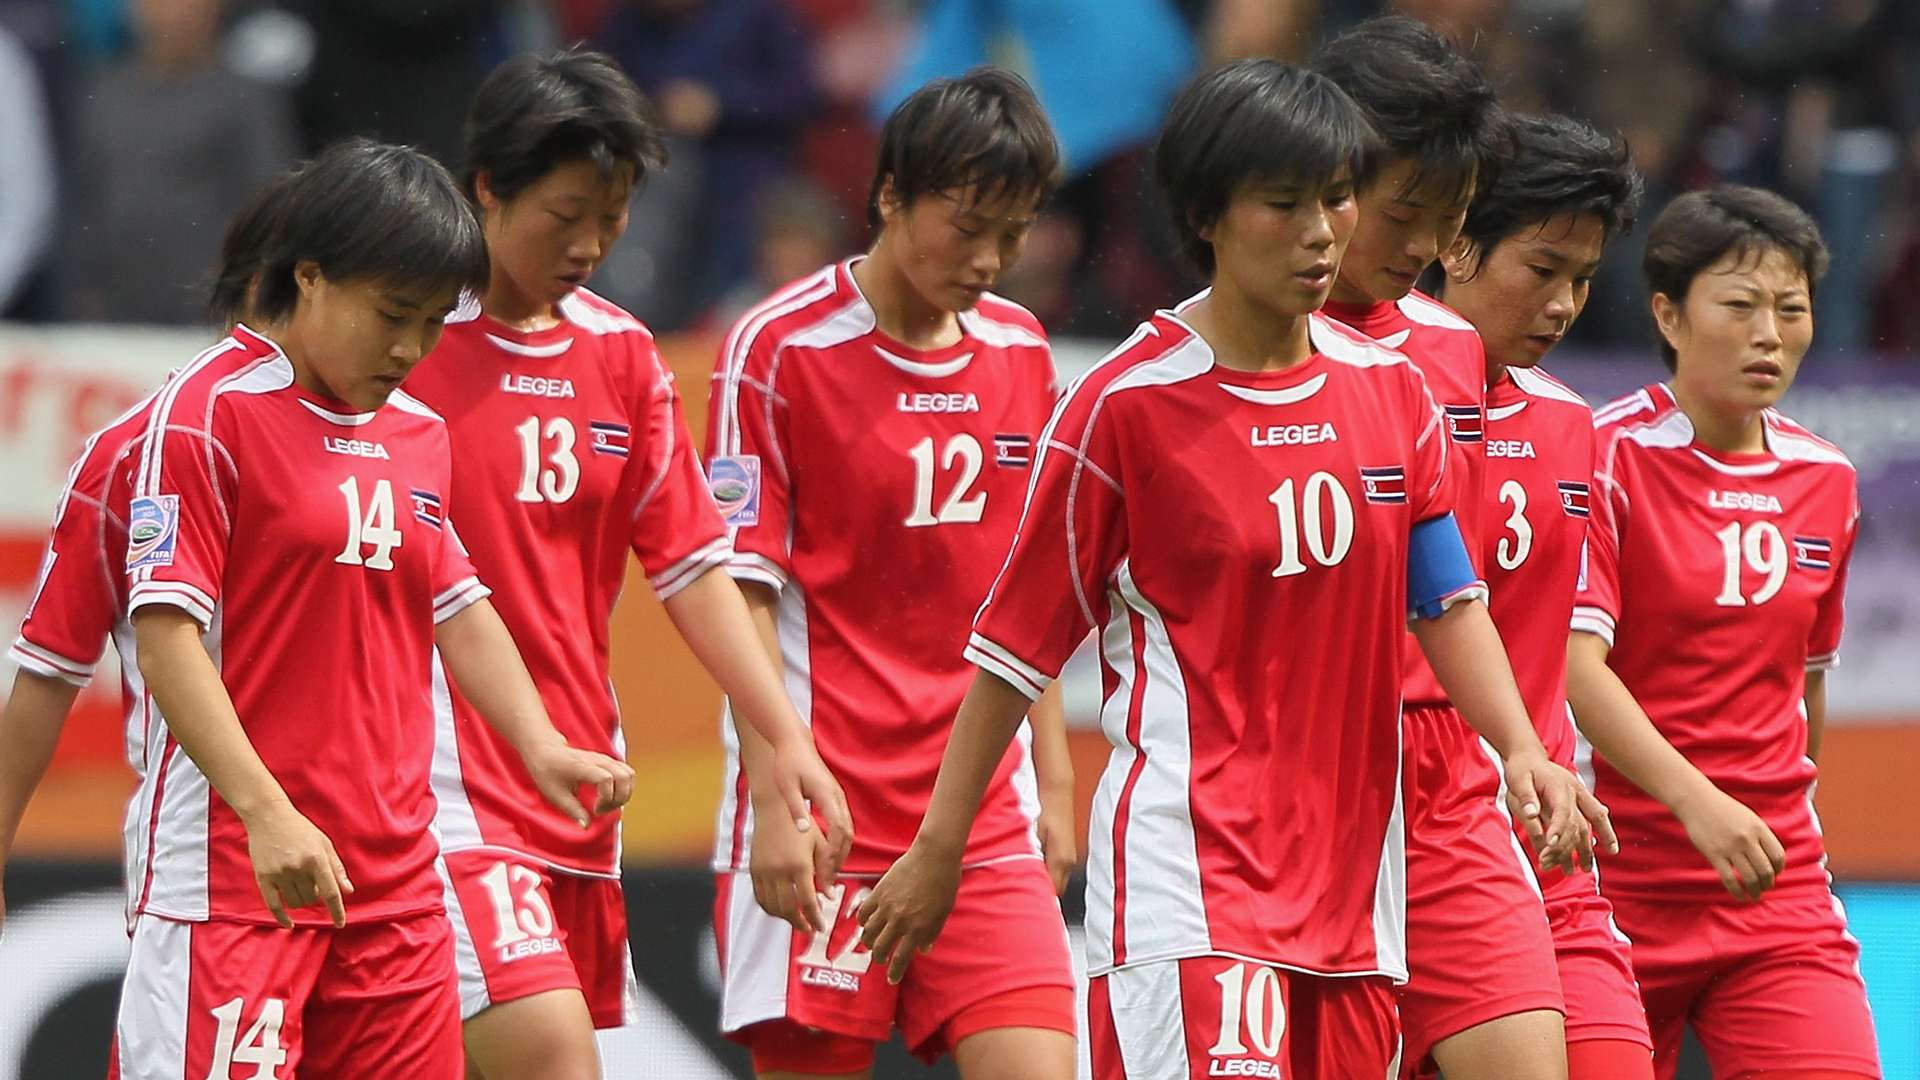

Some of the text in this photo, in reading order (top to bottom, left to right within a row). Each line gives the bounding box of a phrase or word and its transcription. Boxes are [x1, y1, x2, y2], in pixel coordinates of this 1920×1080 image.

[501, 374, 575, 398] LEGEA
[898, 393, 979, 412] LEGEA
[324, 436, 390, 459] LEGEA
[516, 416, 580, 504] 13
[1252, 423, 1338, 446] LEGEA
[1486, 441, 1536, 459] EGEA
[904, 433, 987, 527] 12
[1709, 489, 1783, 513] LEGEA
[335, 476, 402, 571] 14
[1268, 471, 1355, 578] 10
[1497, 480, 1534, 570] 3
[150, 551, 170, 559] FIFA
[1715, 520, 1789, 606] 19
[480, 861, 554, 946] 13
[798, 882, 873, 972] 12
[500, 937, 562, 961] LEGEA
[801, 966, 859, 991] LEGEA
[1208, 962, 1286, 1057] 10
[206, 997, 287, 1080] 14
[1209, 1059, 1281, 1080] LEGEA
